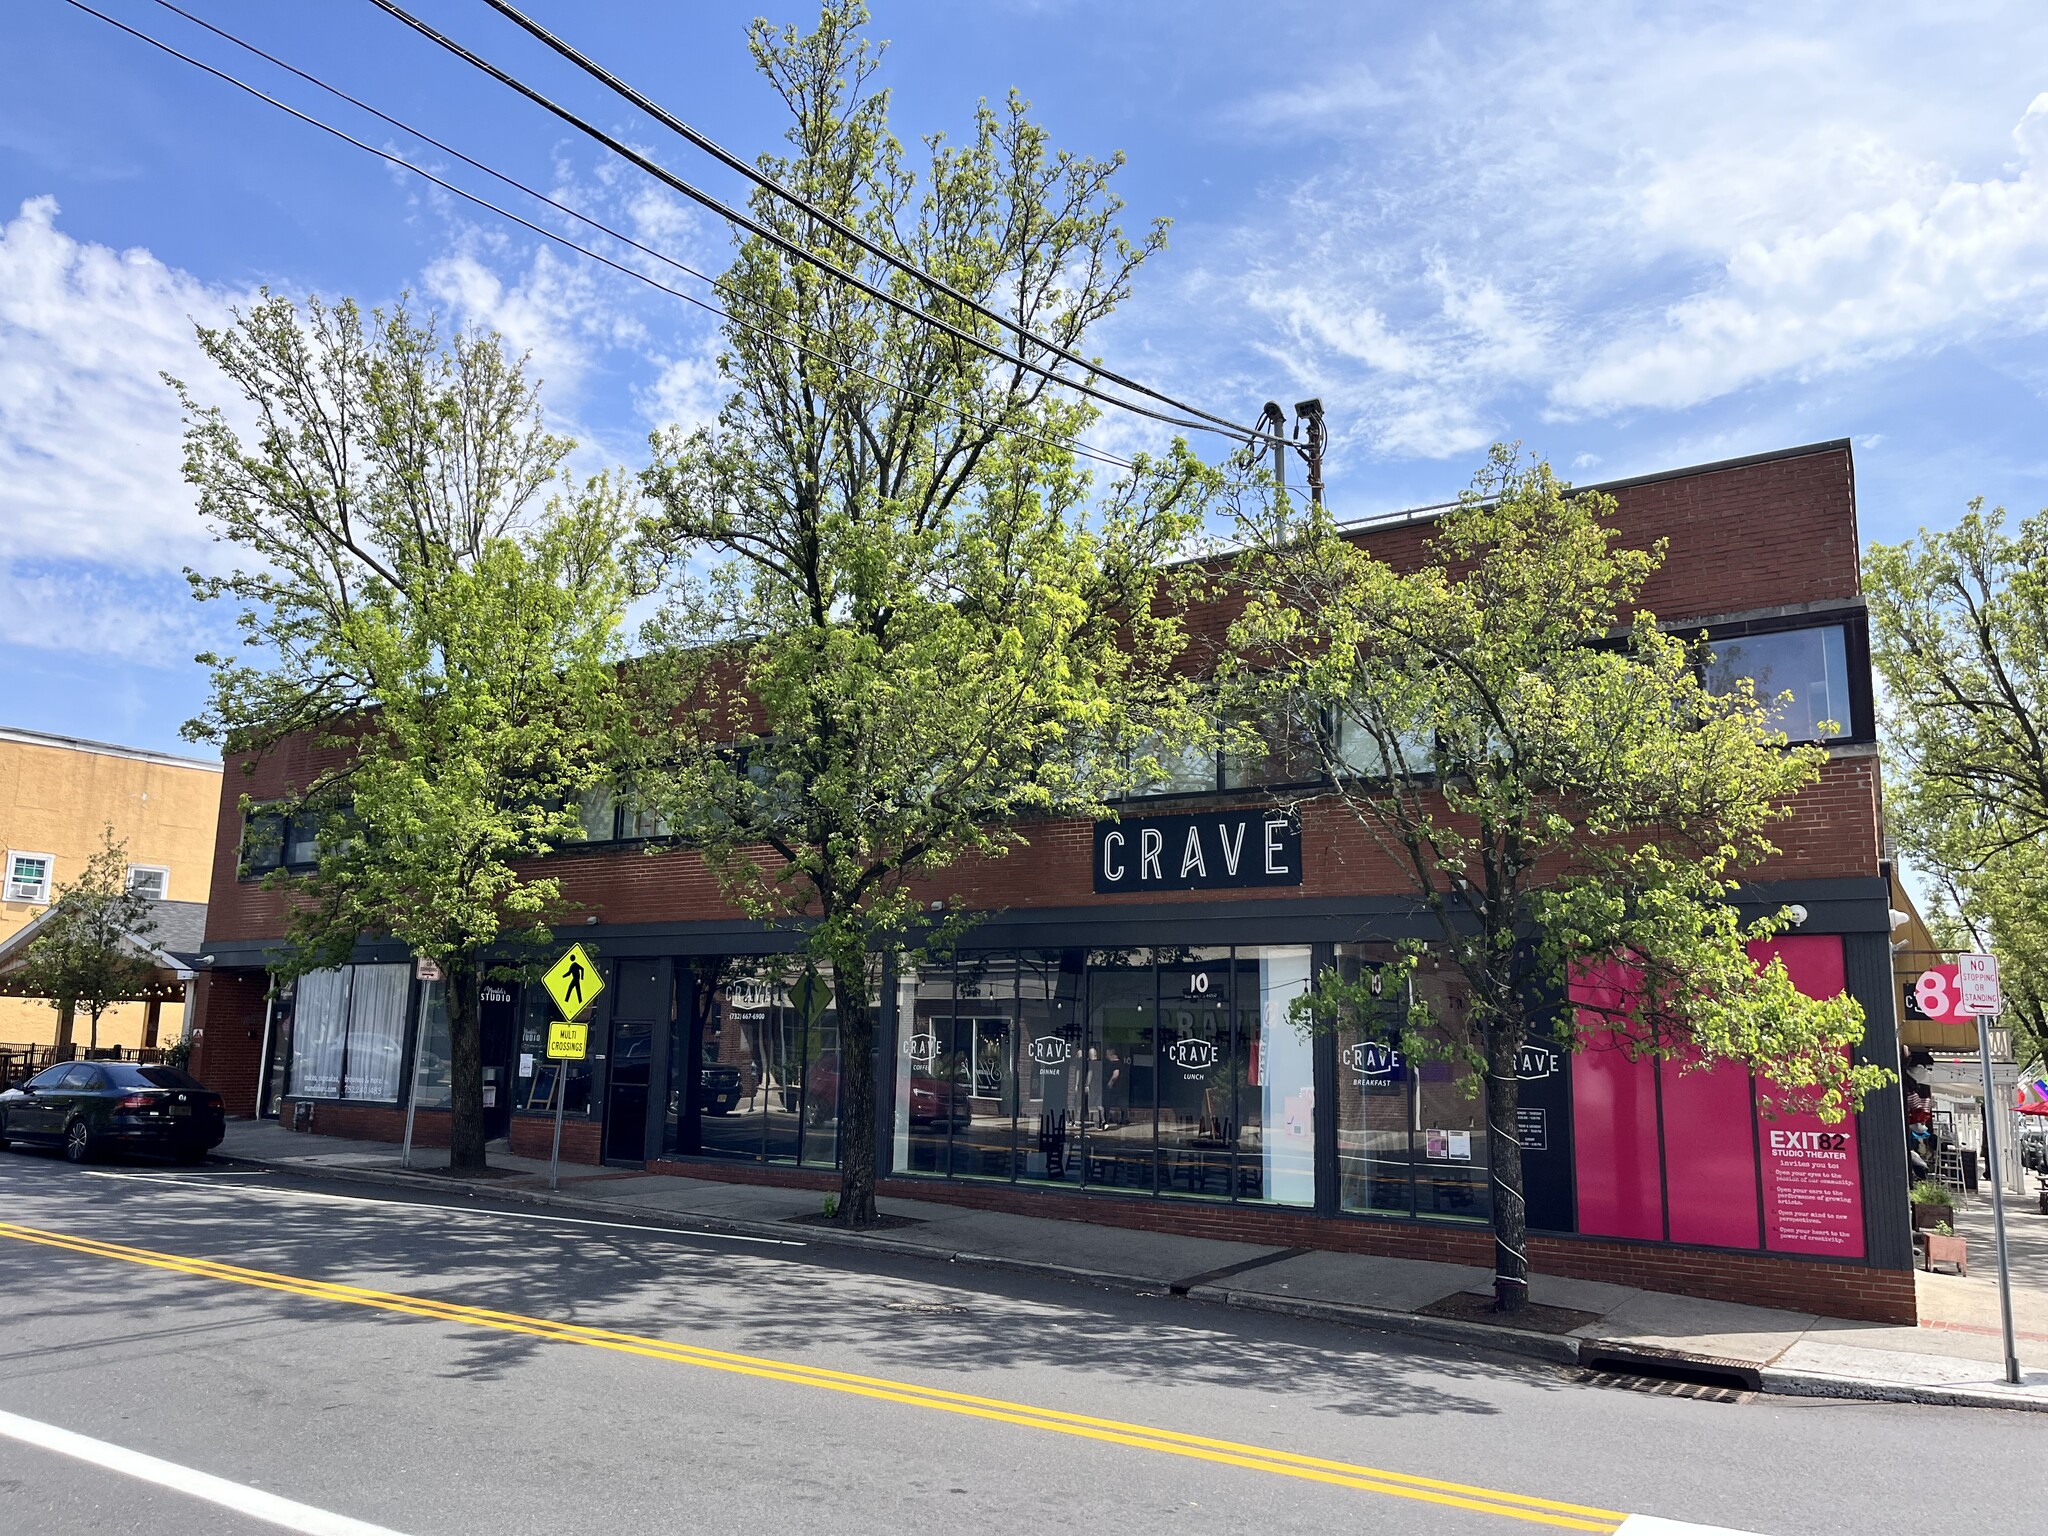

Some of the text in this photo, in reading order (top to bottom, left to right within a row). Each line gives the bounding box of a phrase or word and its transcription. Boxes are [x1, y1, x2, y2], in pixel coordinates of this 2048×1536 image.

[1104, 820, 1289, 881] CRAVE
[1970, 960, 1984, 971] NO
[1190, 972, 1208, 992] 10
[1962, 973, 1994, 982] STOPPING
[480, 993, 510, 1002] STUDIO
[726, 985, 771, 1002] CRAVE
[1964, 994, 1996, 1002] STANDING
[560, 1030, 576, 1040] MULTI
[552, 1042, 582, 1052] CROSSINGS
[903, 1040, 942, 1054] CRAVE
[1028, 1043, 1072, 1058] CRAVE
[1169, 1046, 1218, 1062] CRAVE
[1342, 1050, 1400, 1067] CRAVE
[1353, 1078, 1392, 1086] BREAKFAST
[1772, 1150, 1846, 1160] STUDIO THEATER
